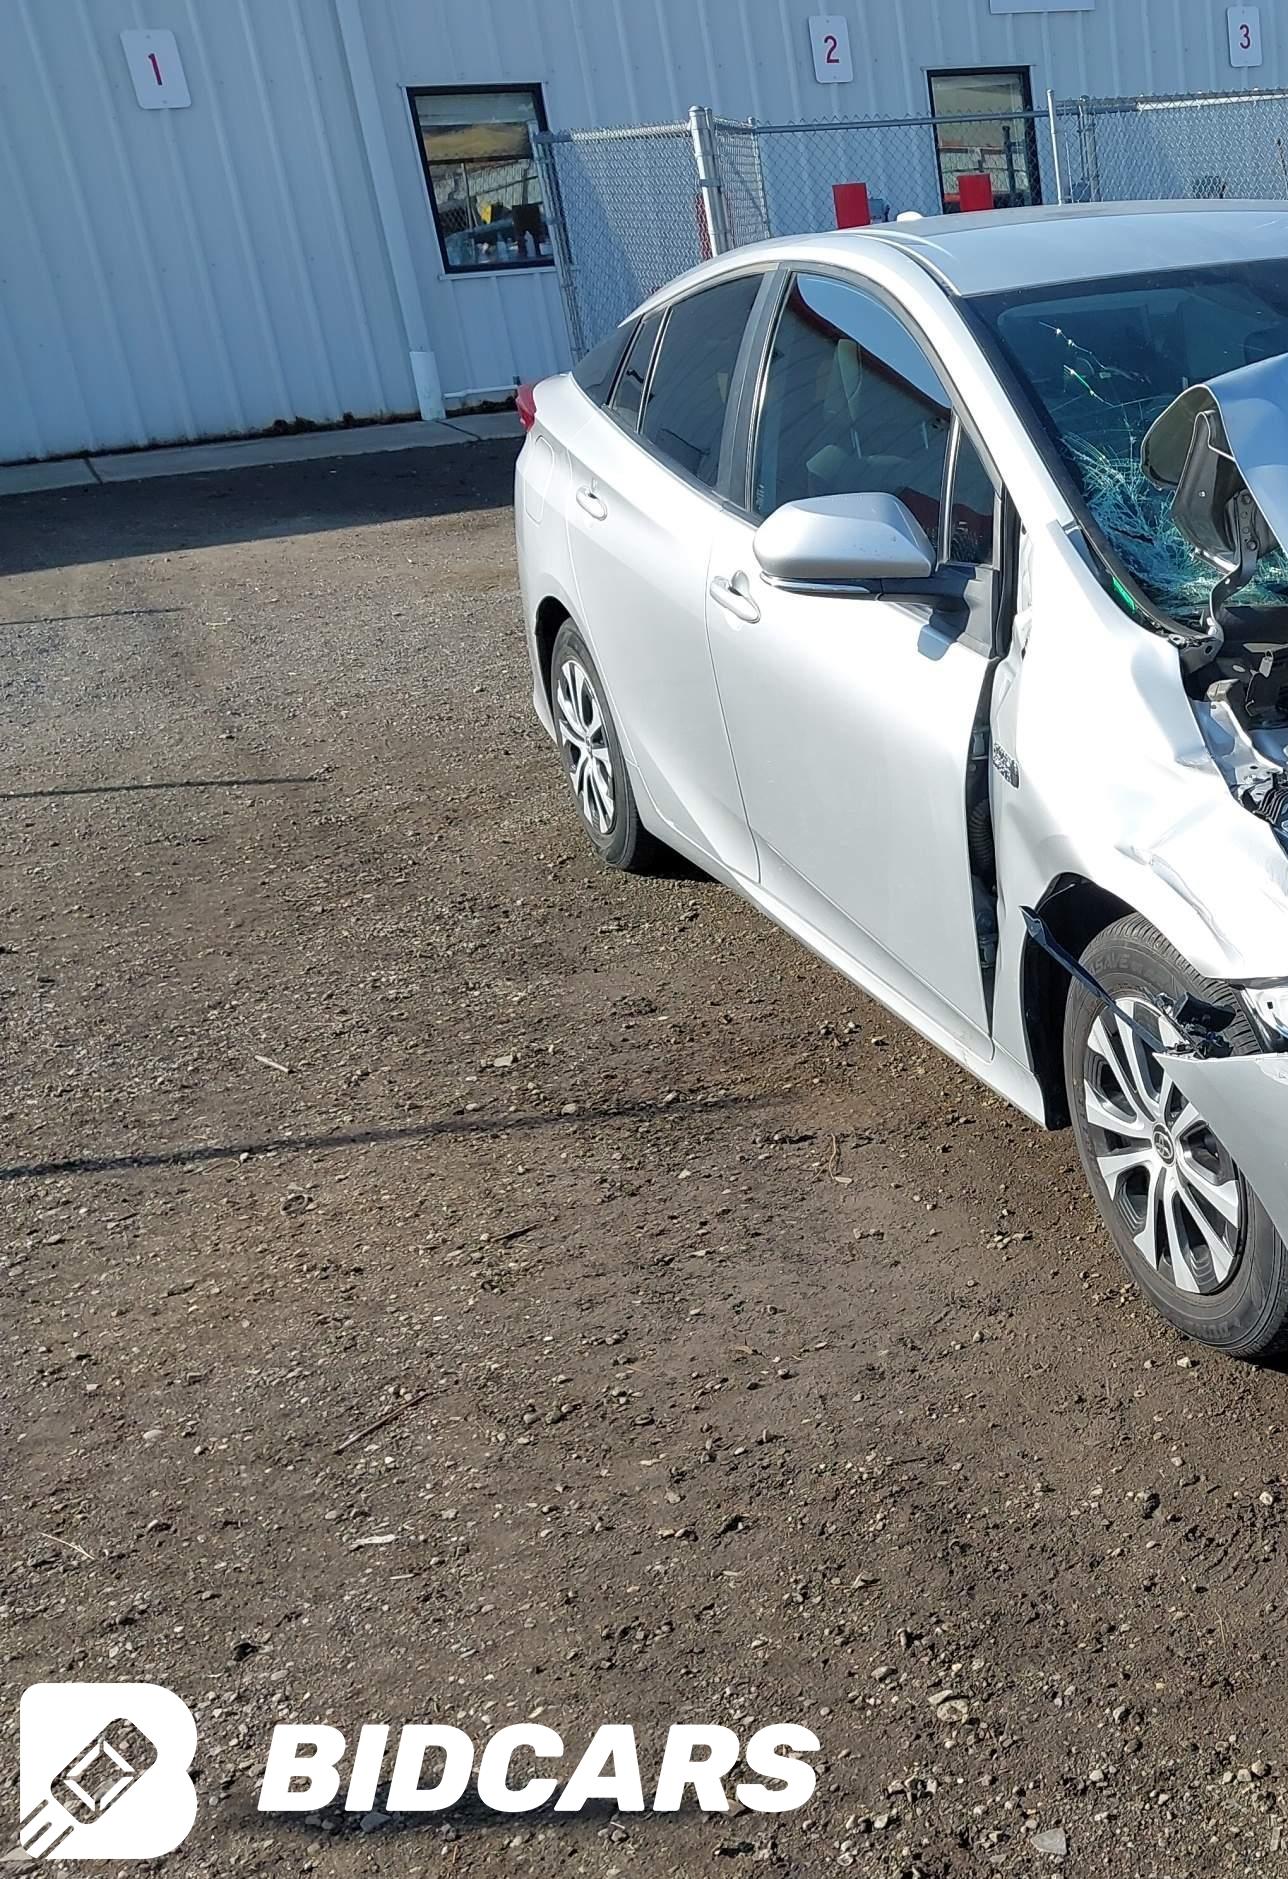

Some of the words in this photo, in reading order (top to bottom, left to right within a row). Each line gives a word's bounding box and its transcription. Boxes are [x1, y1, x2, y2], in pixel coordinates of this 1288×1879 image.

[823, 35, 840, 63] 2
[1239, 23, 1251, 50] 3
[148, 53, 162, 86] 1
